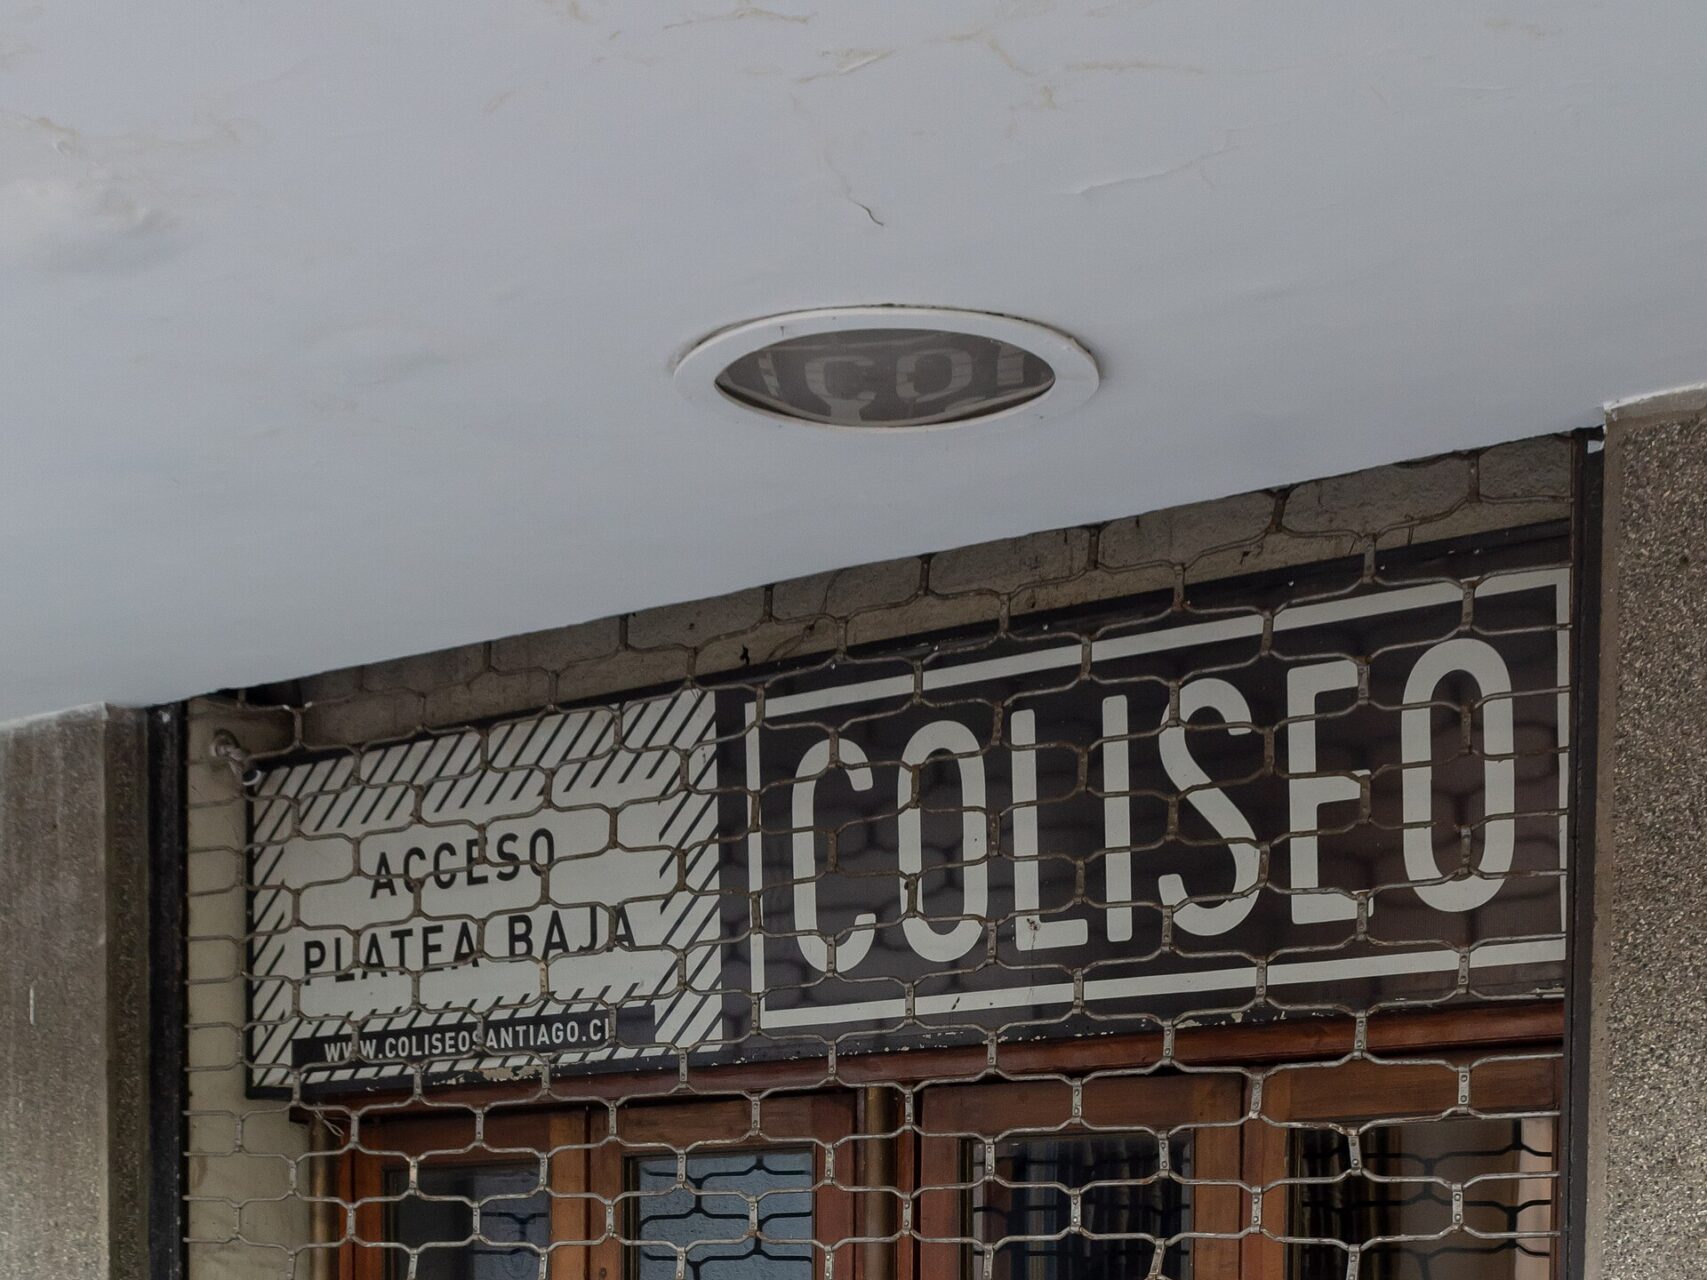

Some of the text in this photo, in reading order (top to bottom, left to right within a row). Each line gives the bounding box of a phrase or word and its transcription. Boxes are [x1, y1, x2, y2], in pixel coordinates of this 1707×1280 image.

[791, 638, 1515, 973] COLISEO
[370, 828, 555, 899] ACCESO
[303, 904, 636, 986] PLATEA BAJA
